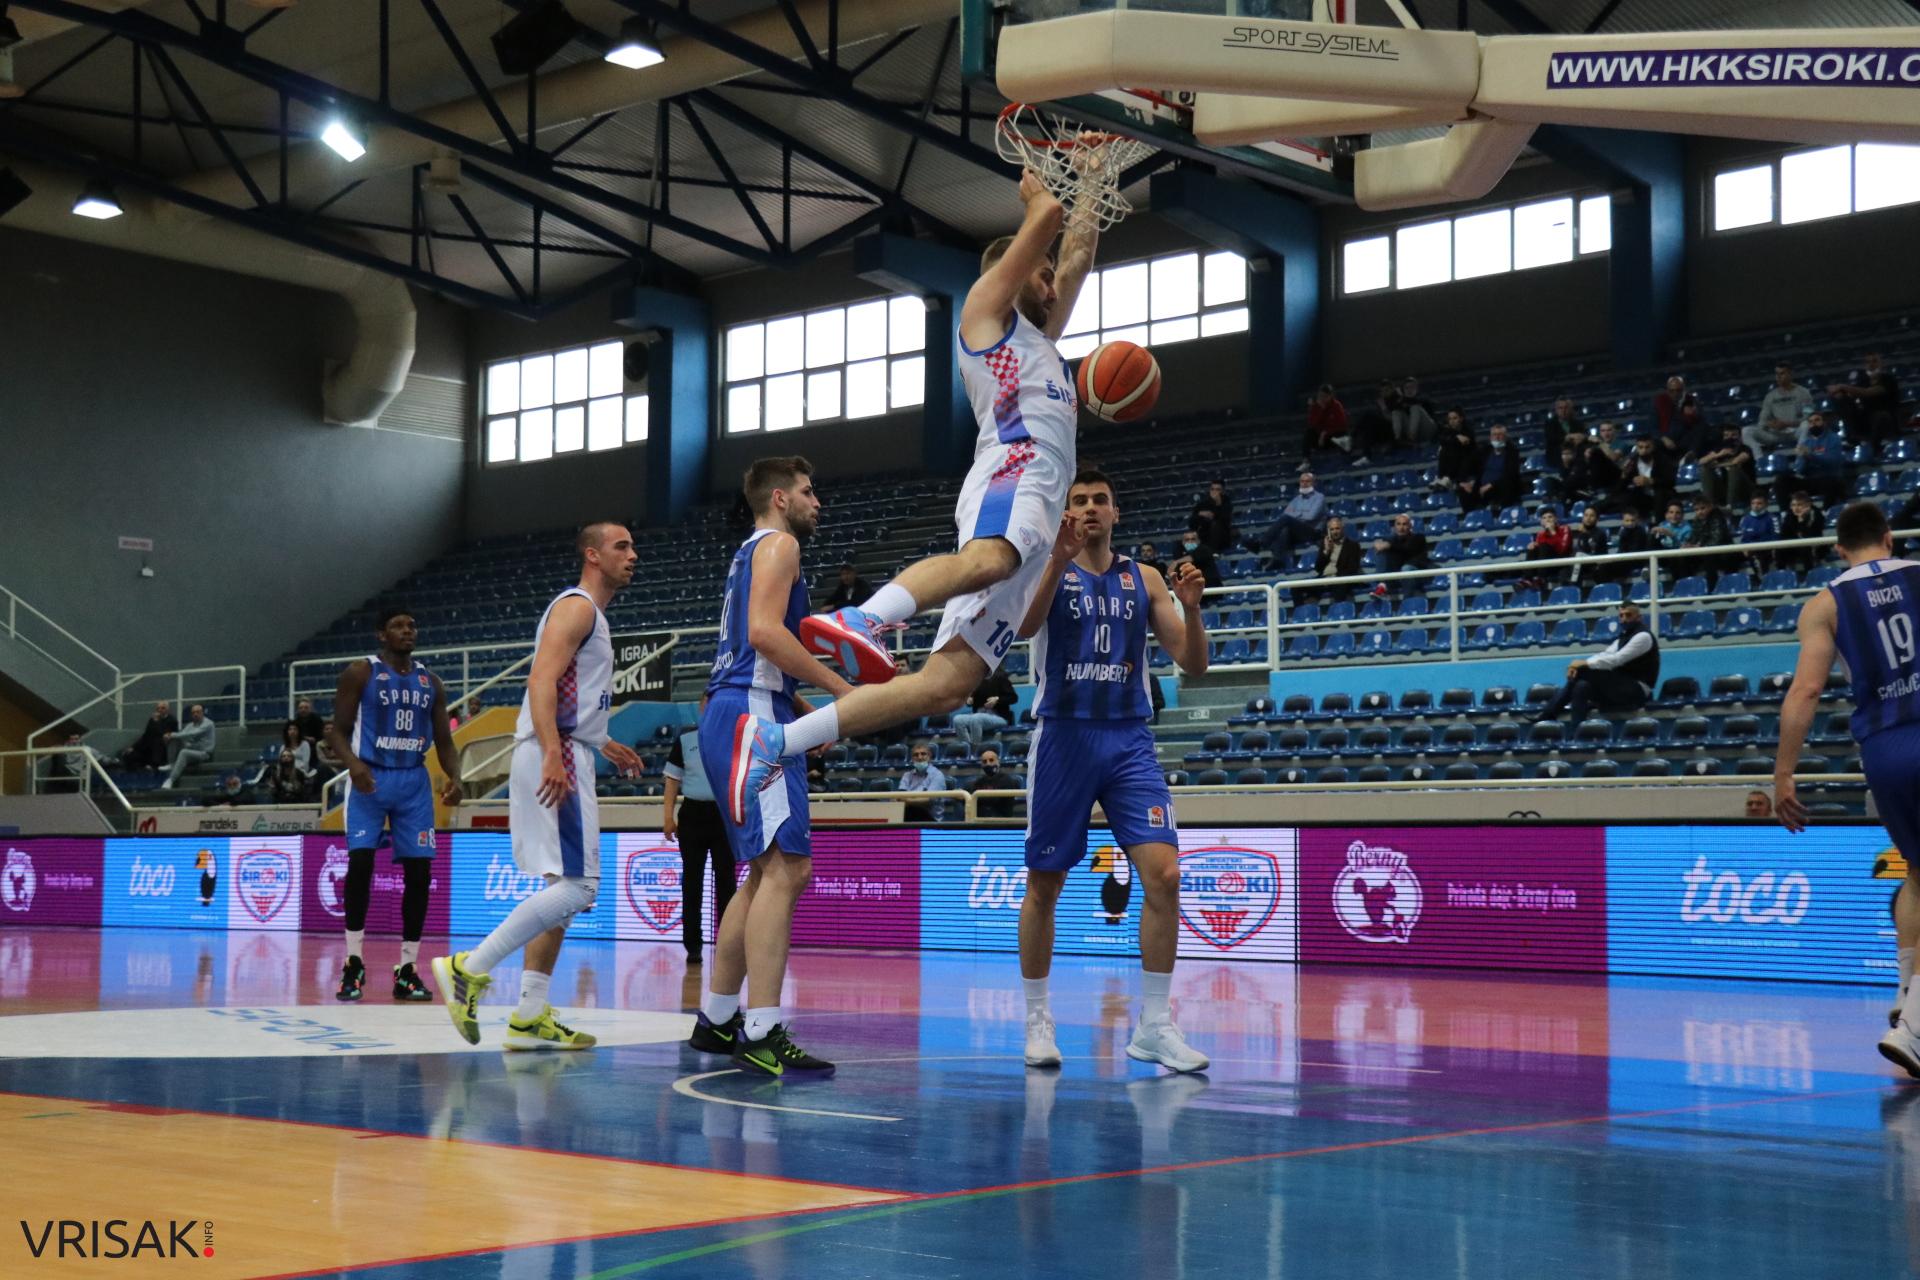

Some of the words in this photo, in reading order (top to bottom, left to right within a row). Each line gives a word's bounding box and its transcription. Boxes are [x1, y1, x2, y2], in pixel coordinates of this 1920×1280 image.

[1223, 27, 1301, 46] SPORT
[1069, 595, 1135, 620] SPARS
[1866, 585, 1904, 608] BUZA
[986, 619, 1015, 659] 19
[1094, 624, 1111, 654] 10
[1877, 612, 1916, 671] 19
[1065, 662, 1129, 683] NUMBER1
[379, 689, 430, 708] SPARS
[395, 709, 414, 731] 88
[129, 855, 175, 897] toco
[1680, 854, 1811, 925] toco
